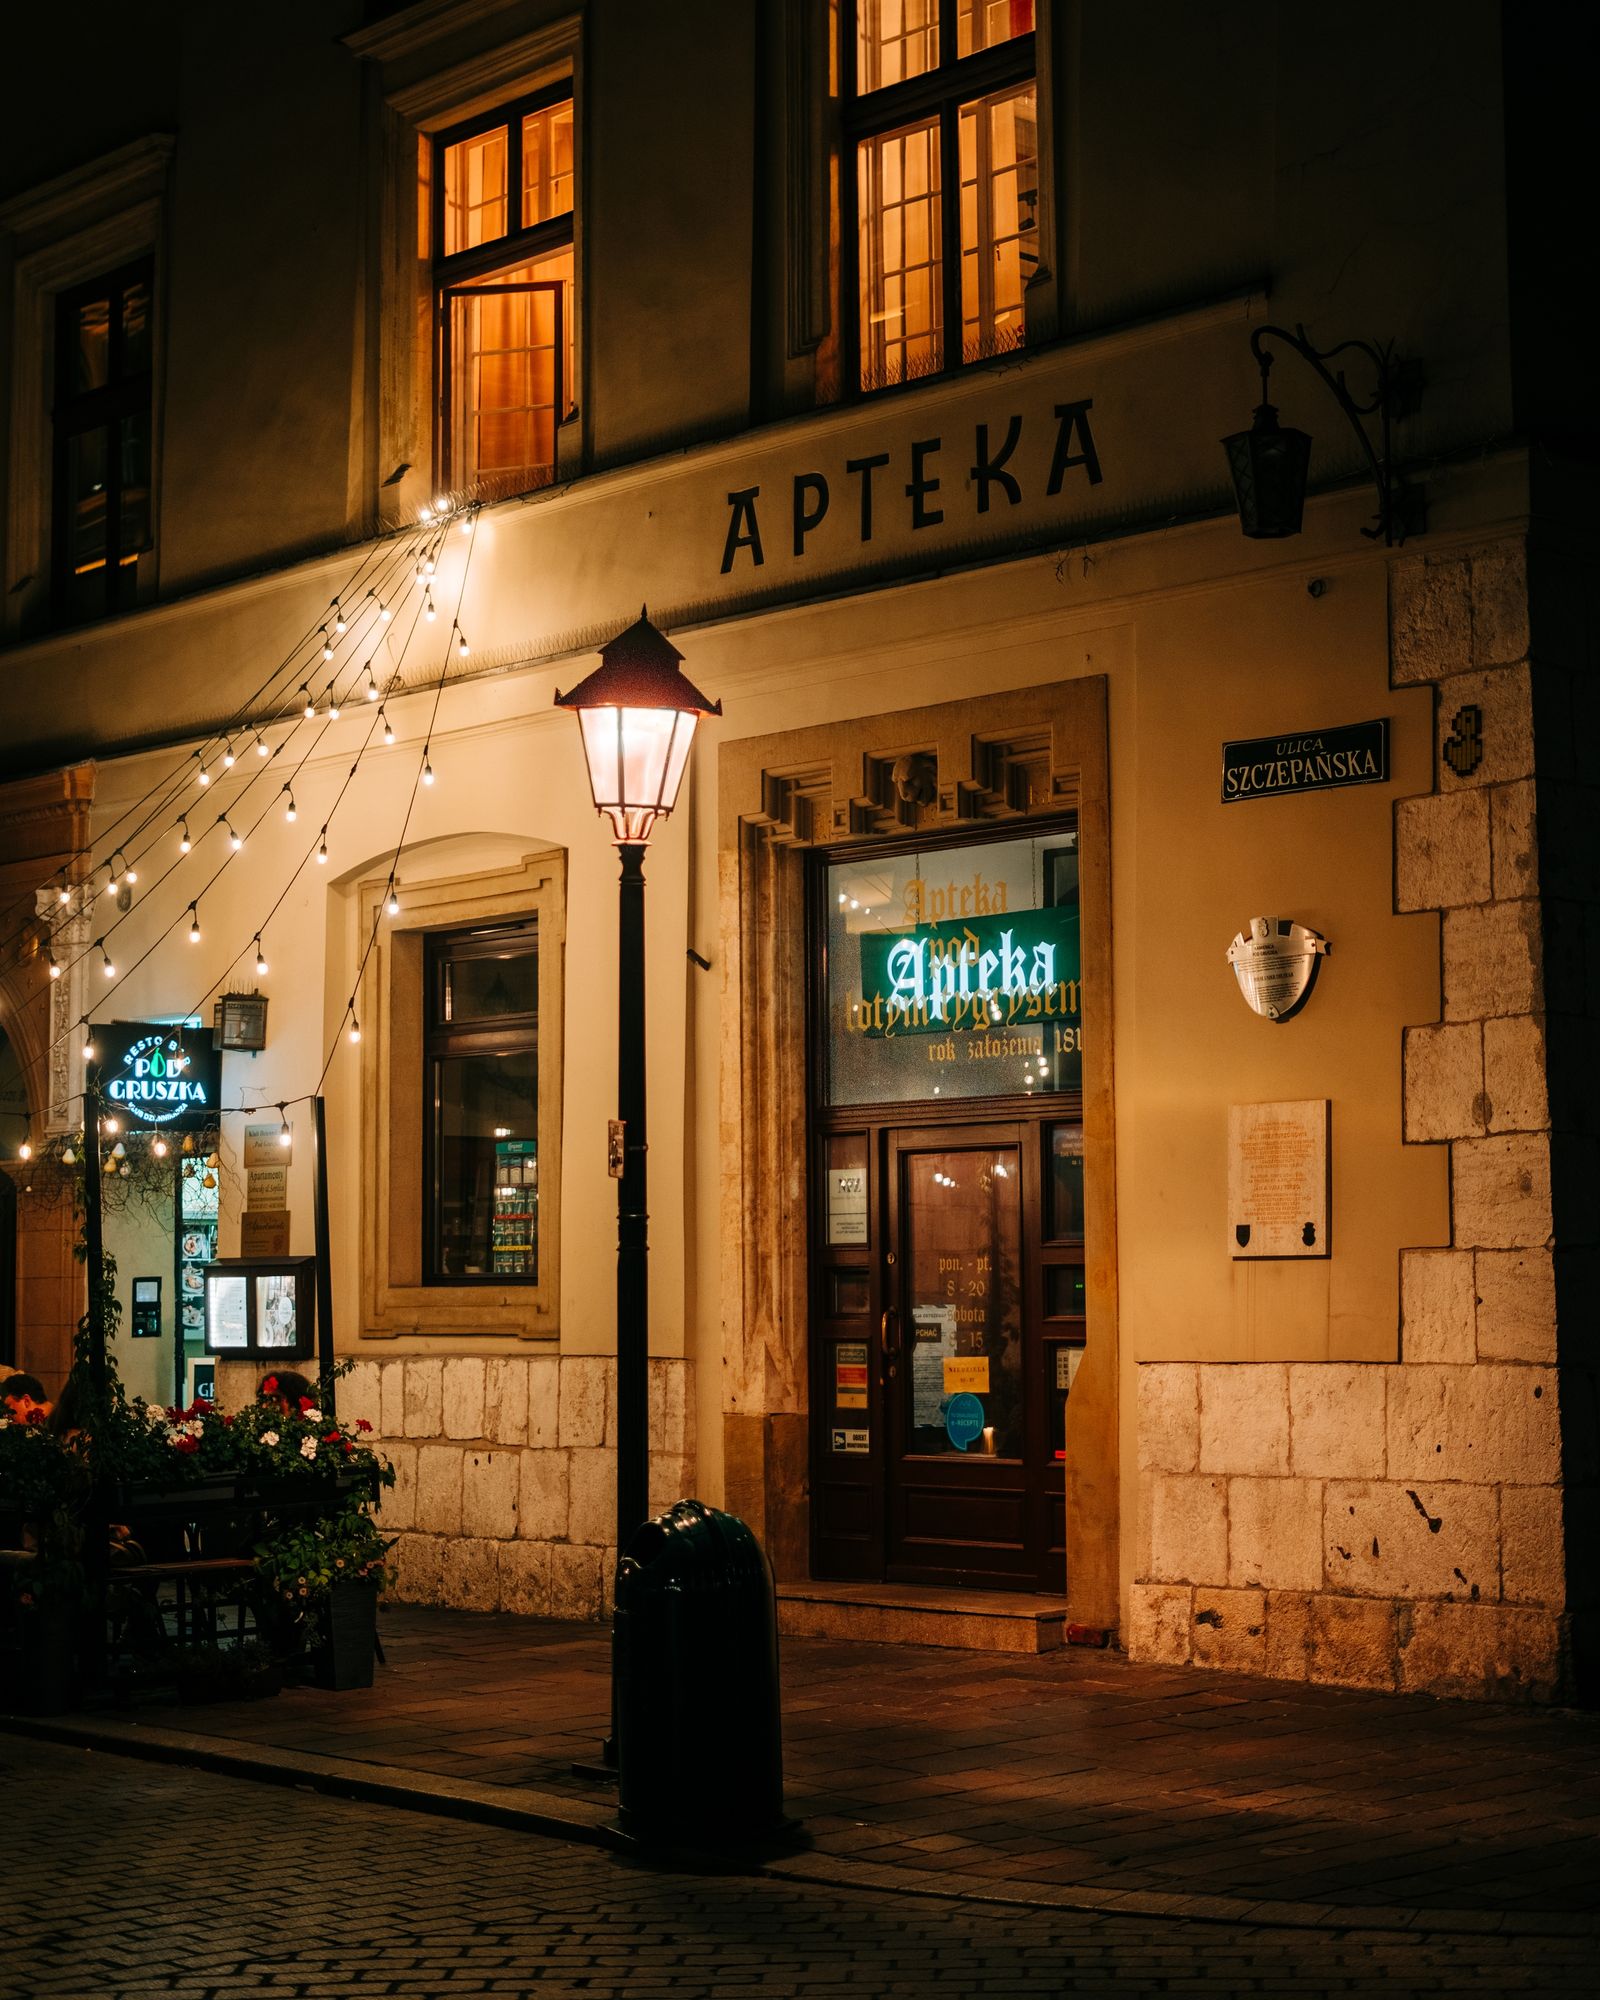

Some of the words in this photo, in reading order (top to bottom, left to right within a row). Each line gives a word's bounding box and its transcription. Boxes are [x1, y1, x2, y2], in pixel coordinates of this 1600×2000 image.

[720, 399, 1103, 574] APTEKA
[1276, 738, 1325, 756] ULICA
[903, 872, 1008, 930] Apteka
[887, 929, 1058, 1020] Apteka
[123, 1036, 163, 1065] RESTO
[928, 1038, 955, 1062] rok
[109, 1080, 207, 1103] GRUSZKĄ
[838, 1178, 861, 1193] NFZ
[939, 1257, 963, 1273] pon.
[977, 1256, 992, 1273] pt.
[968, 1280, 985, 1296] 20
[915, 1328, 938, 1337] PCHAĆ
[970, 1331, 984, 1348] 15
